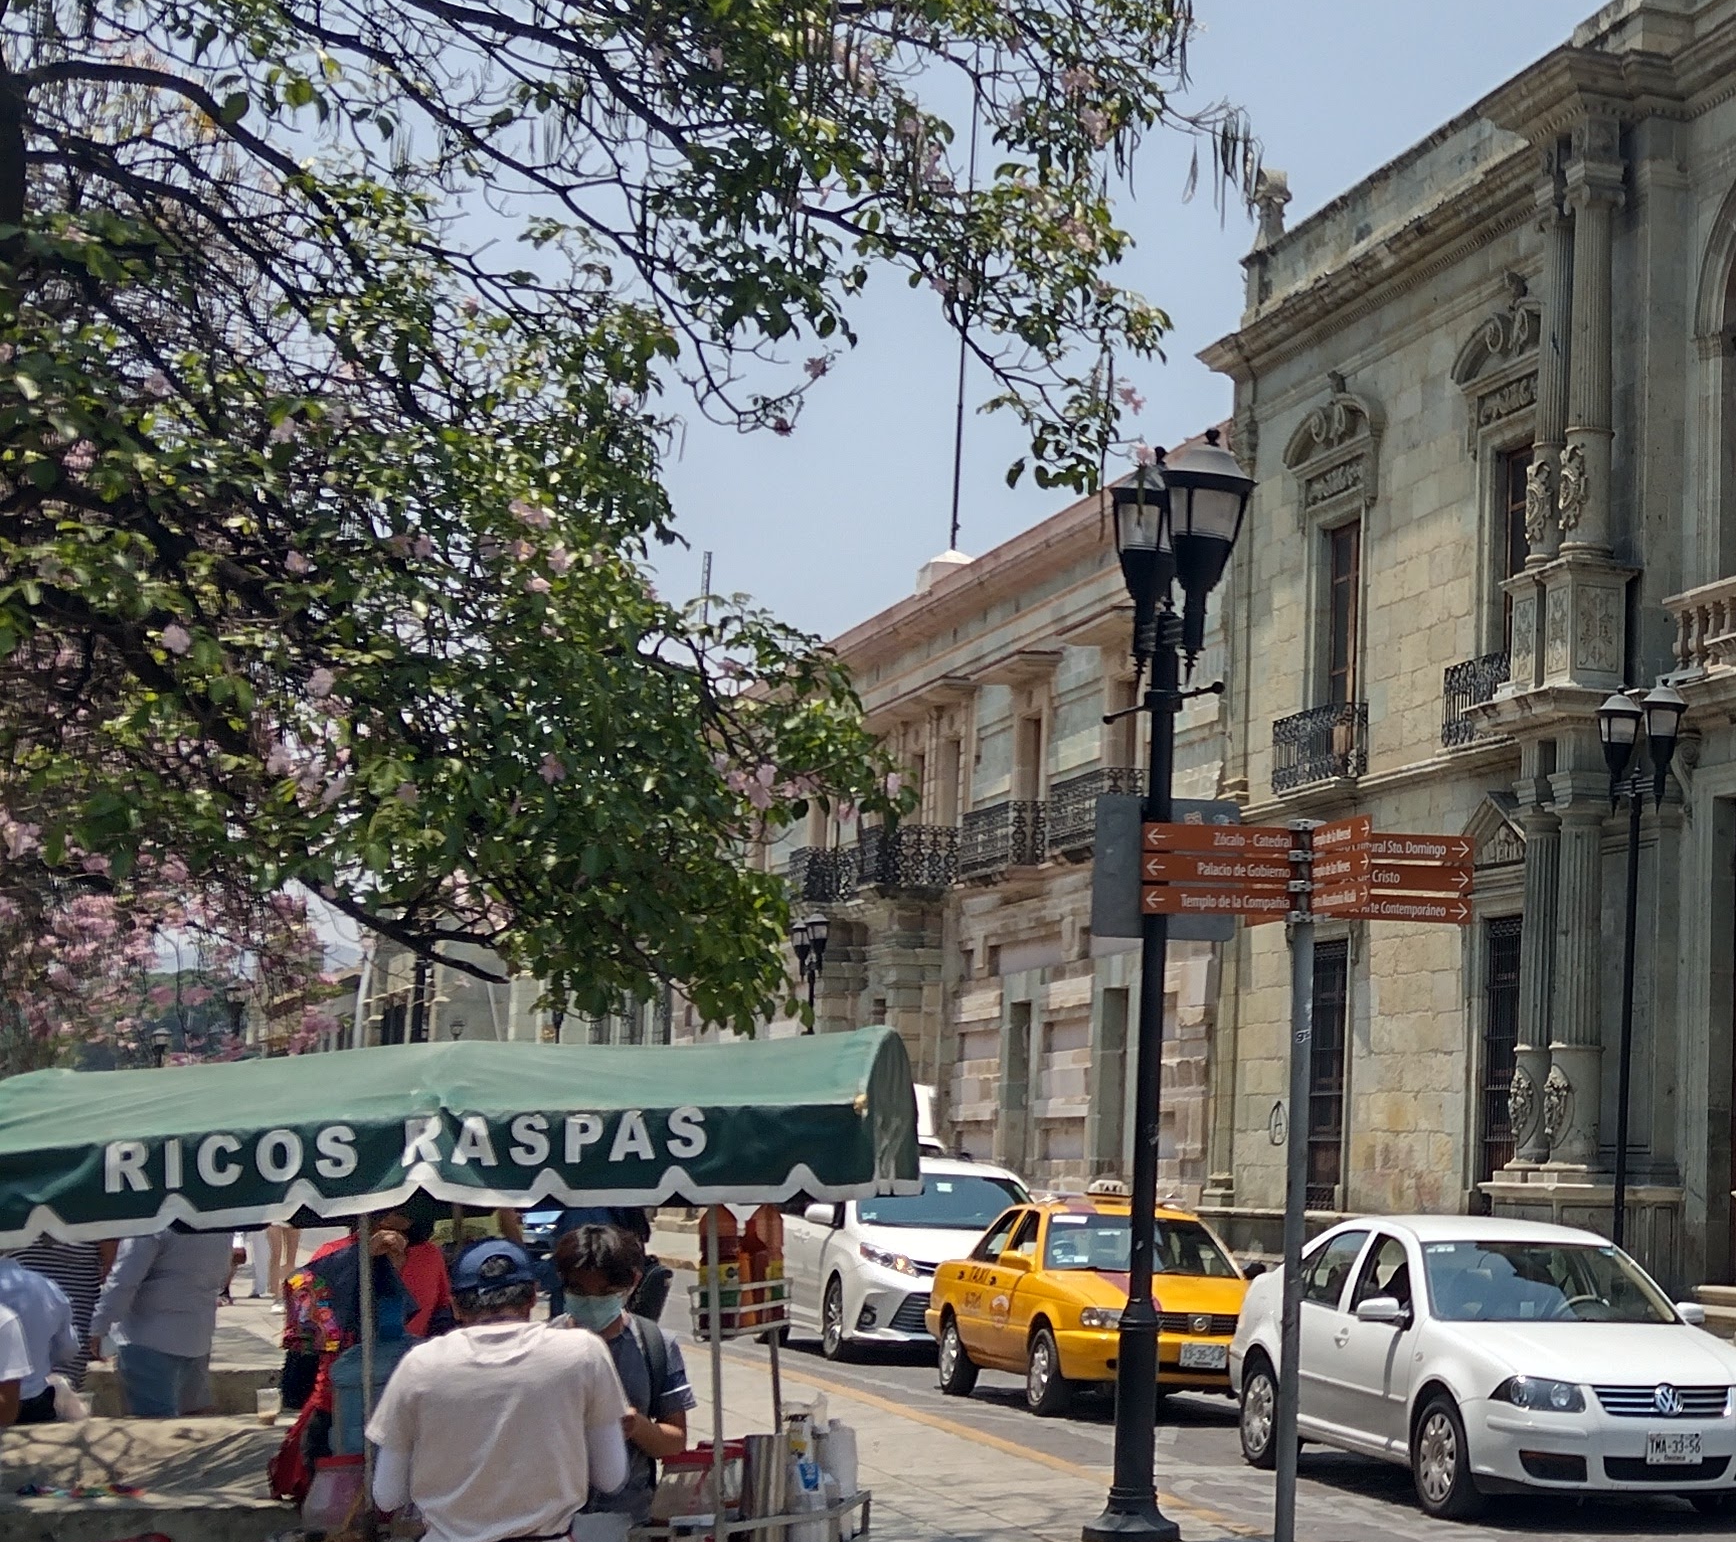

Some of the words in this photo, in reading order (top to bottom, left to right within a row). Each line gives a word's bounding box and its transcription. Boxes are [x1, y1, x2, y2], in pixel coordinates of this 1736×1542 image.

[1213, 832, 1245, 846] Zócalo
[1253, 833, 1293, 848] Catedral
[1388, 840, 1404, 854] Sto.
[1406, 841, 1447, 858] Domingo
[1197, 862, 1232, 876] Palacio
[1233, 863, 1246, 877] de
[1247, 864, 1291, 878] Gobierno
[1372, 869, 1400, 884] Cristo
[1180, 893, 1216, 910] Templo
[1218, 894, 1231, 908] de
[1232, 895, 1241, 908] la
[1243, 895, 1291, 911] Compañía
[1380, 901, 1447, 918] Contemporáneo
[105, 1126, 358, 1193] RICOS
[401, 1107, 708, 1168] RASPAS
[1099, 1183, 1122, 1194] TAXI
